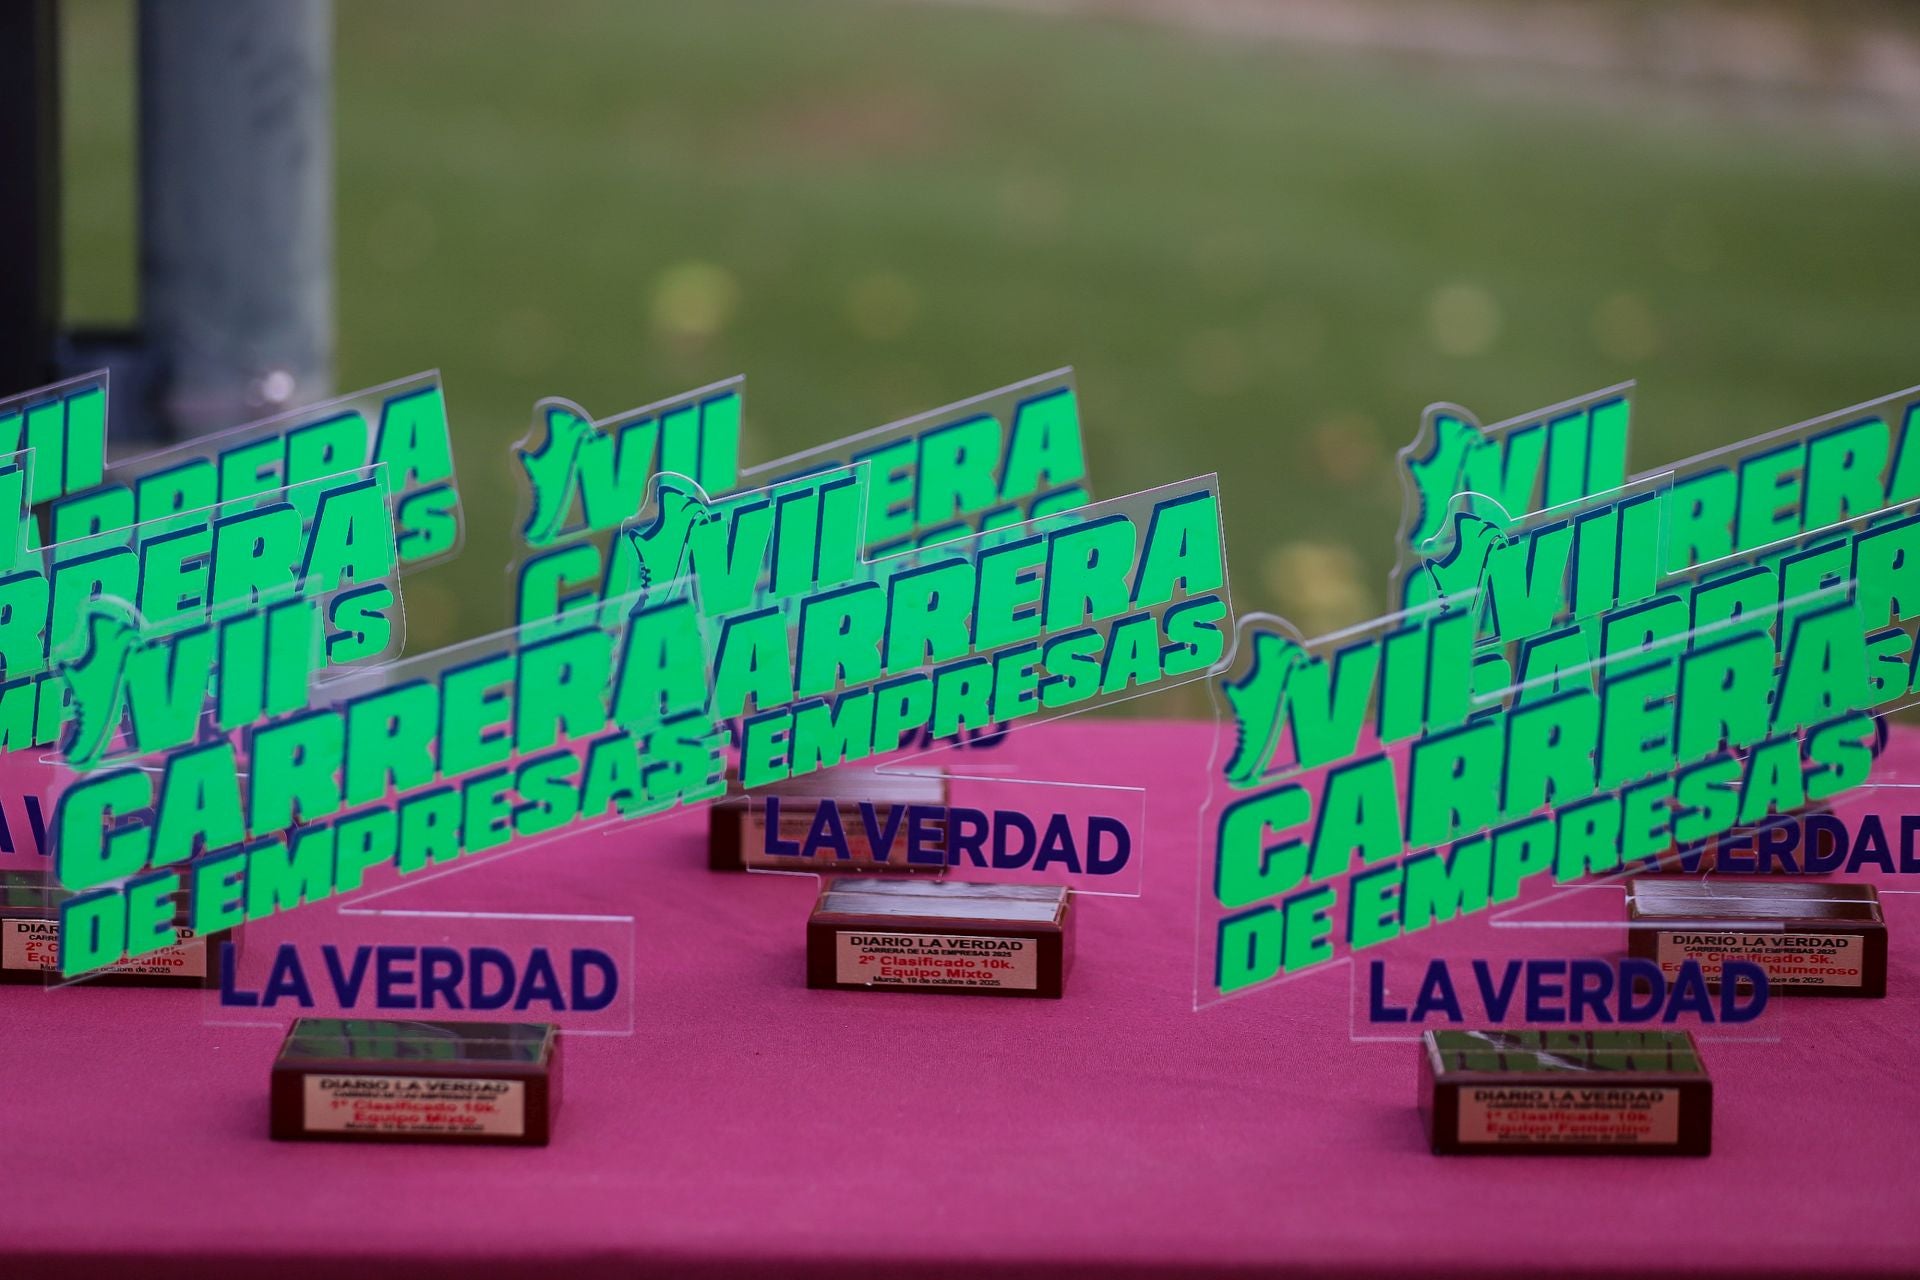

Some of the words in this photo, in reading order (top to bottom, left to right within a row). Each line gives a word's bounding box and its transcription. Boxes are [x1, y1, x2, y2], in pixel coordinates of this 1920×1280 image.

[692, 475, 862, 617] VII
[1486, 492, 1661, 660] VII
[706, 490, 1224, 722] ARRERA
[126, 594, 316, 756] VII
[740, 596, 1227, 789] EMPRESAS
[1287, 606, 1473, 770] VII
[58, 597, 712, 890] CARRERA
[1213, 600, 1872, 909] CARRERA
[60, 868, 178, 978] DE
[190, 708, 710, 938] EMPRESAS
[764, 796, 851, 861] LA
[857, 800, 1131, 875] VERDAD
[1215, 884, 1337, 995] DE
[1345, 711, 1875, 951] EMPRESAS
[17, 923, 60, 934] DIAR
[850, 935, 914, 947] DIARIO
[919, 938, 943, 948] LA
[946, 938, 1023, 951] VERDAD
[859, 955, 875, 965] 2º
[880, 956, 975, 969] Clasificado
[981, 959, 1015, 970] 10k.
[1672, 935, 1736, 946] DIARIO
[1742, 937, 1766, 946] LA
[1770, 938, 1849, 948] VERDAD
[1707, 953, 1804, 964] Clasificado
[1809, 954, 1835, 964] 5k.
[219, 941, 315, 1008] LA
[321, 945, 619, 1012] VERDAD
[881, 967, 942, 979] Equipo
[946, 968, 993, 979] Mixto
[1369, 959, 1463, 1023] LA
[1471, 959, 1770, 1025] VERDAD
[1769, 965, 1859, 976] Numeroso
[320, 1078, 389, 1090] DIARIO
[395, 1080, 421, 1091] LA
[424, 1080, 510, 1093] VERDAD
[1475, 1090, 1543, 1102] DIARIO
[1549, 1090, 1575, 1101] LA
[1580, 1090, 1664, 1103] VERDAD
